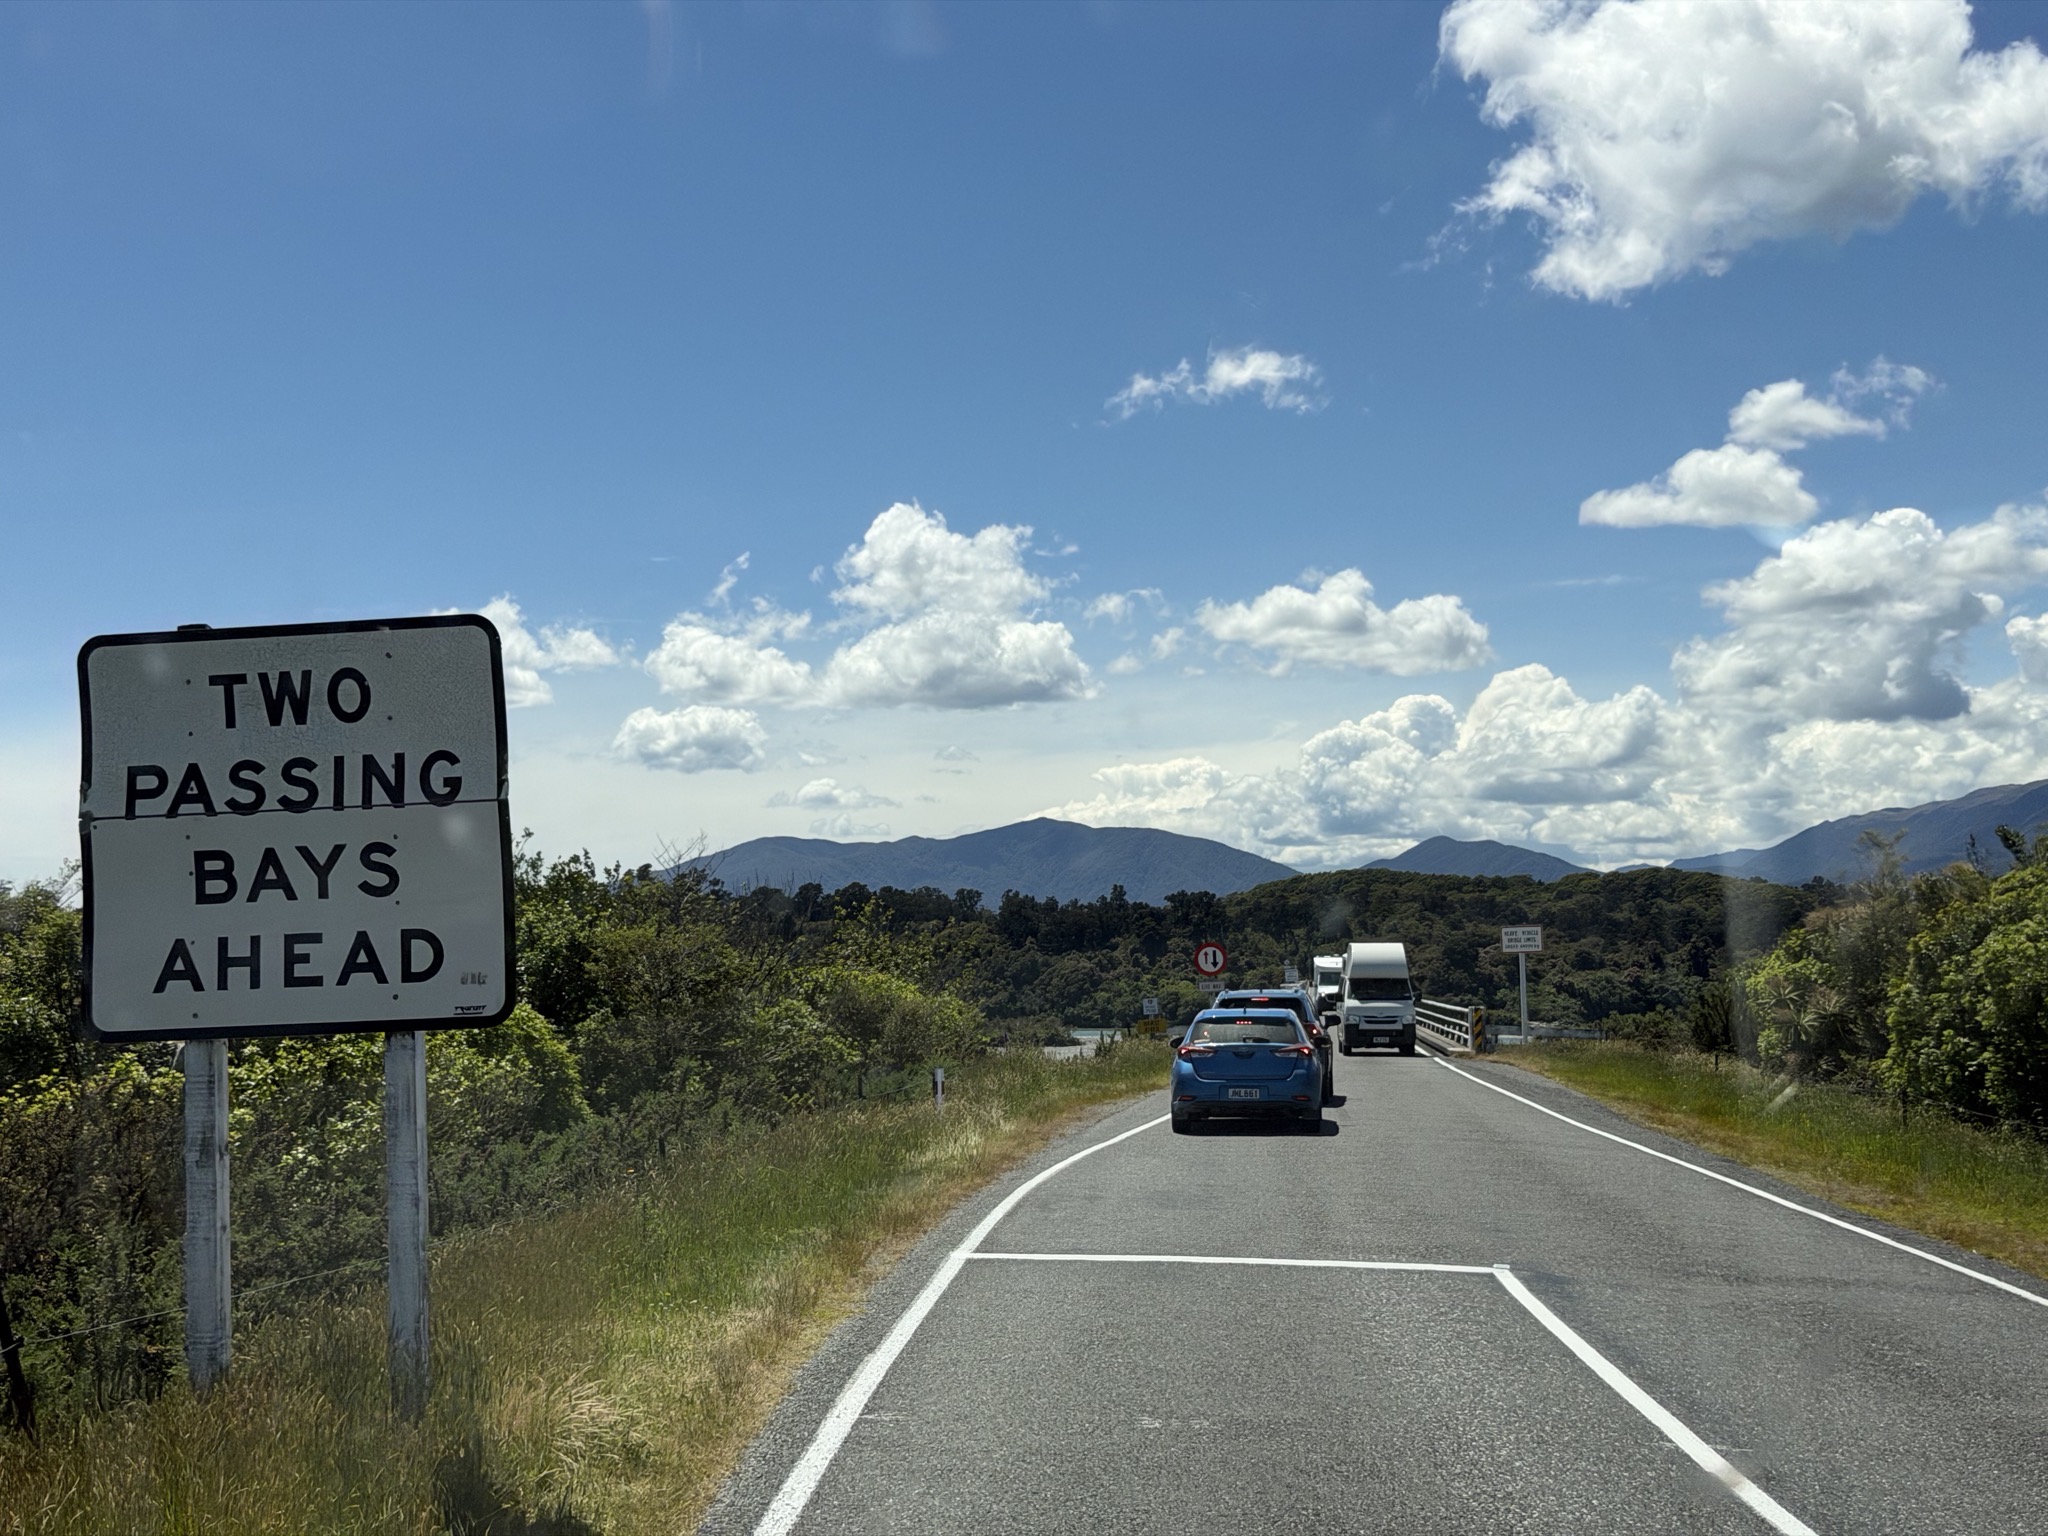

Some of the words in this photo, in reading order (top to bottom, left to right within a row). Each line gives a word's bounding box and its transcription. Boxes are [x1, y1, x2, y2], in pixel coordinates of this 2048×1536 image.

[208, 667, 371, 729] TWO
[125, 750, 463, 820] PASSING
[193, 841, 400, 905] BAYS
[152, 928, 445, 994] AHEAD
